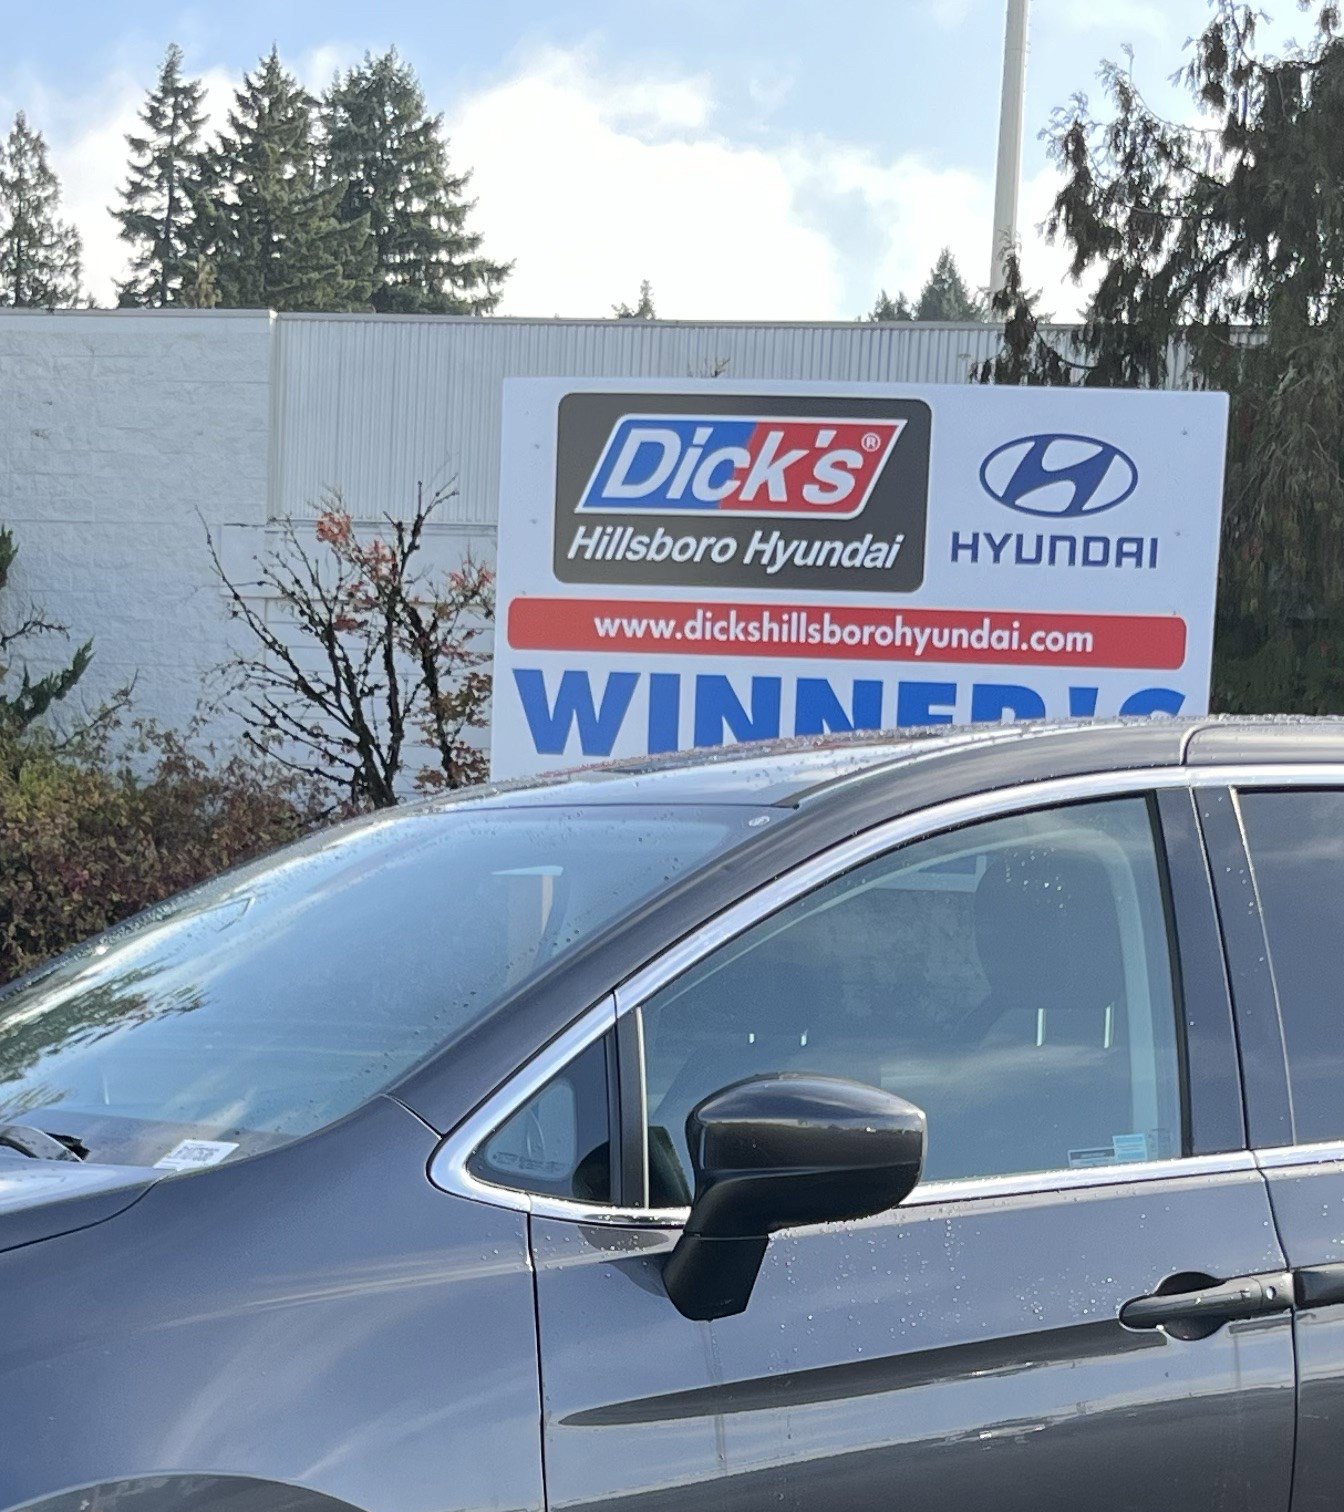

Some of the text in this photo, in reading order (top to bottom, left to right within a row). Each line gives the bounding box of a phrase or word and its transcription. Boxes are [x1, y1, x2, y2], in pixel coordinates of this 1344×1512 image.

[602, 427, 863, 505] Dick's
[567, 526, 904, 574] Hillsboro Hyundai
[951, 532, 1157, 569] HYUNDAI
[593, 611, 1094, 656] www.dickshillsborohyundai.com
